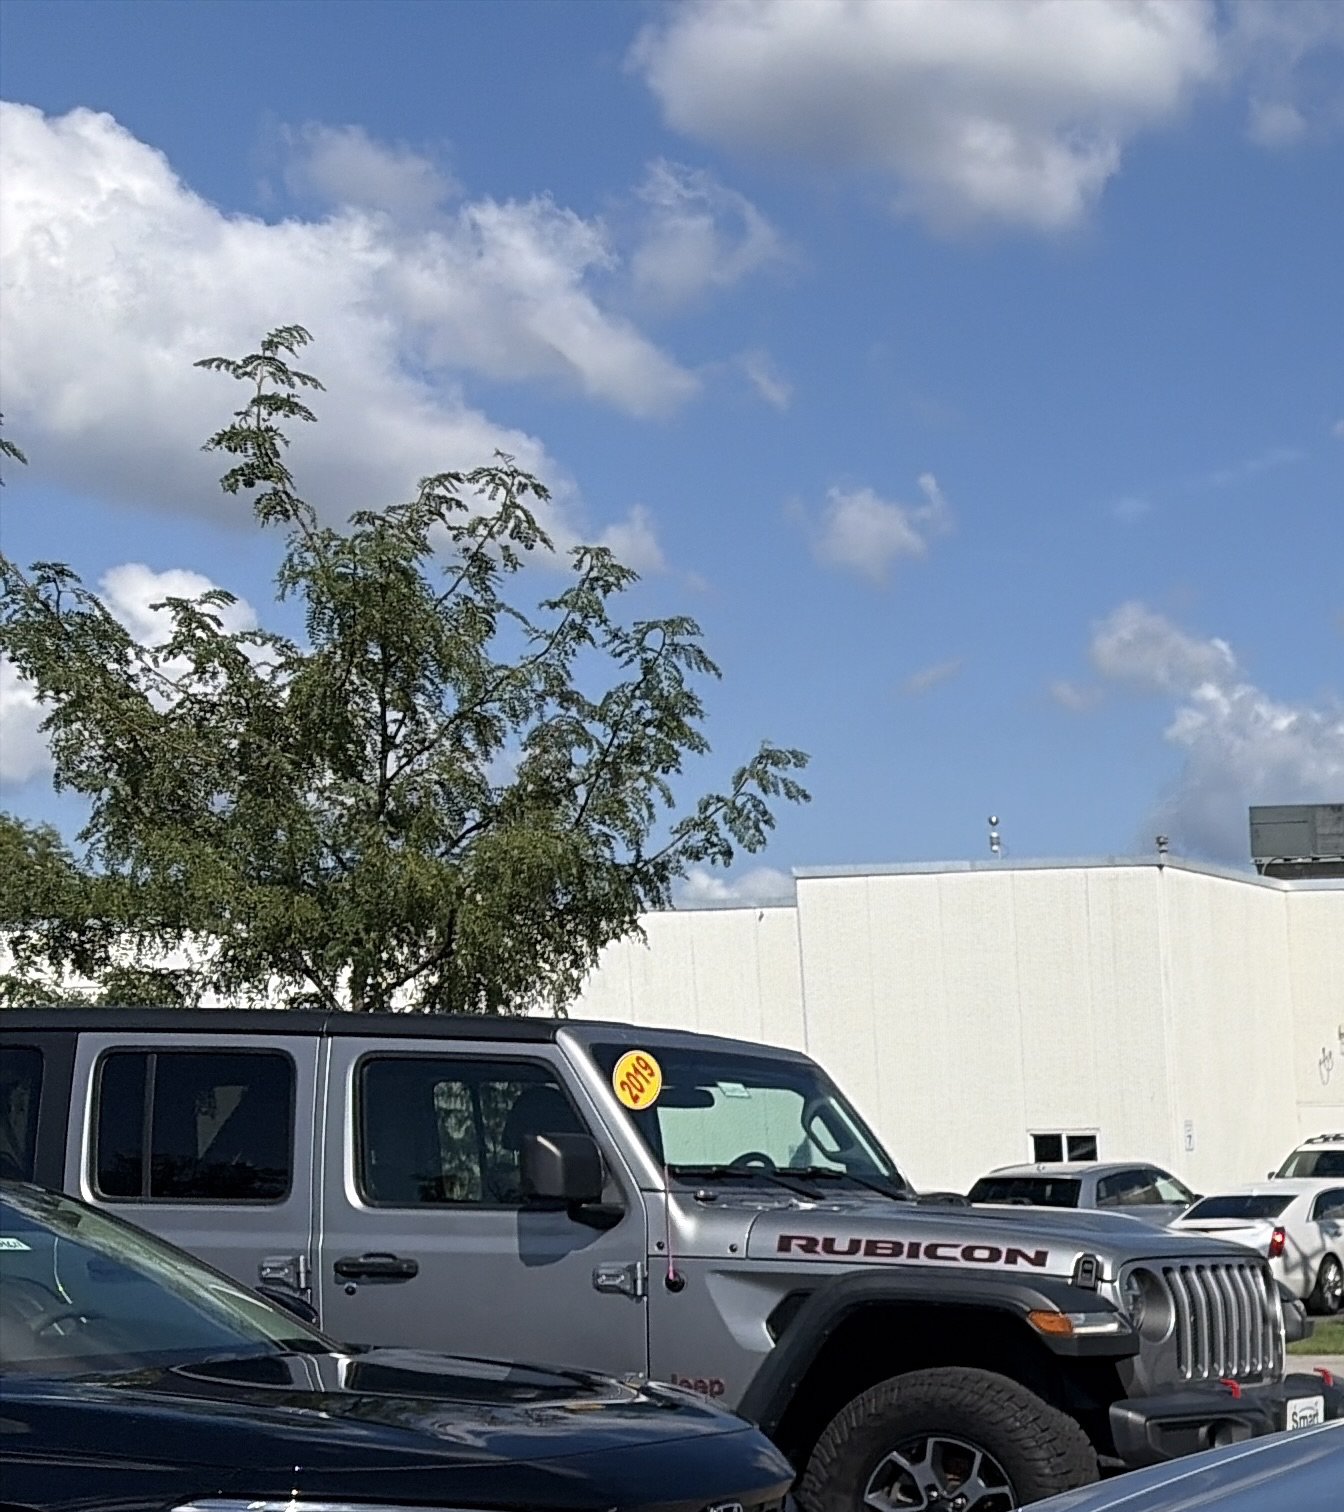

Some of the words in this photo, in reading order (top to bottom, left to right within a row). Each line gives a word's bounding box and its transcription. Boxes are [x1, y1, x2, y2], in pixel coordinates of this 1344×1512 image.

[620, 1055, 656, 1104] 2019
[776, 1234, 1049, 1267] RUBICON
[1291, 1408, 1320, 1430] Smart
